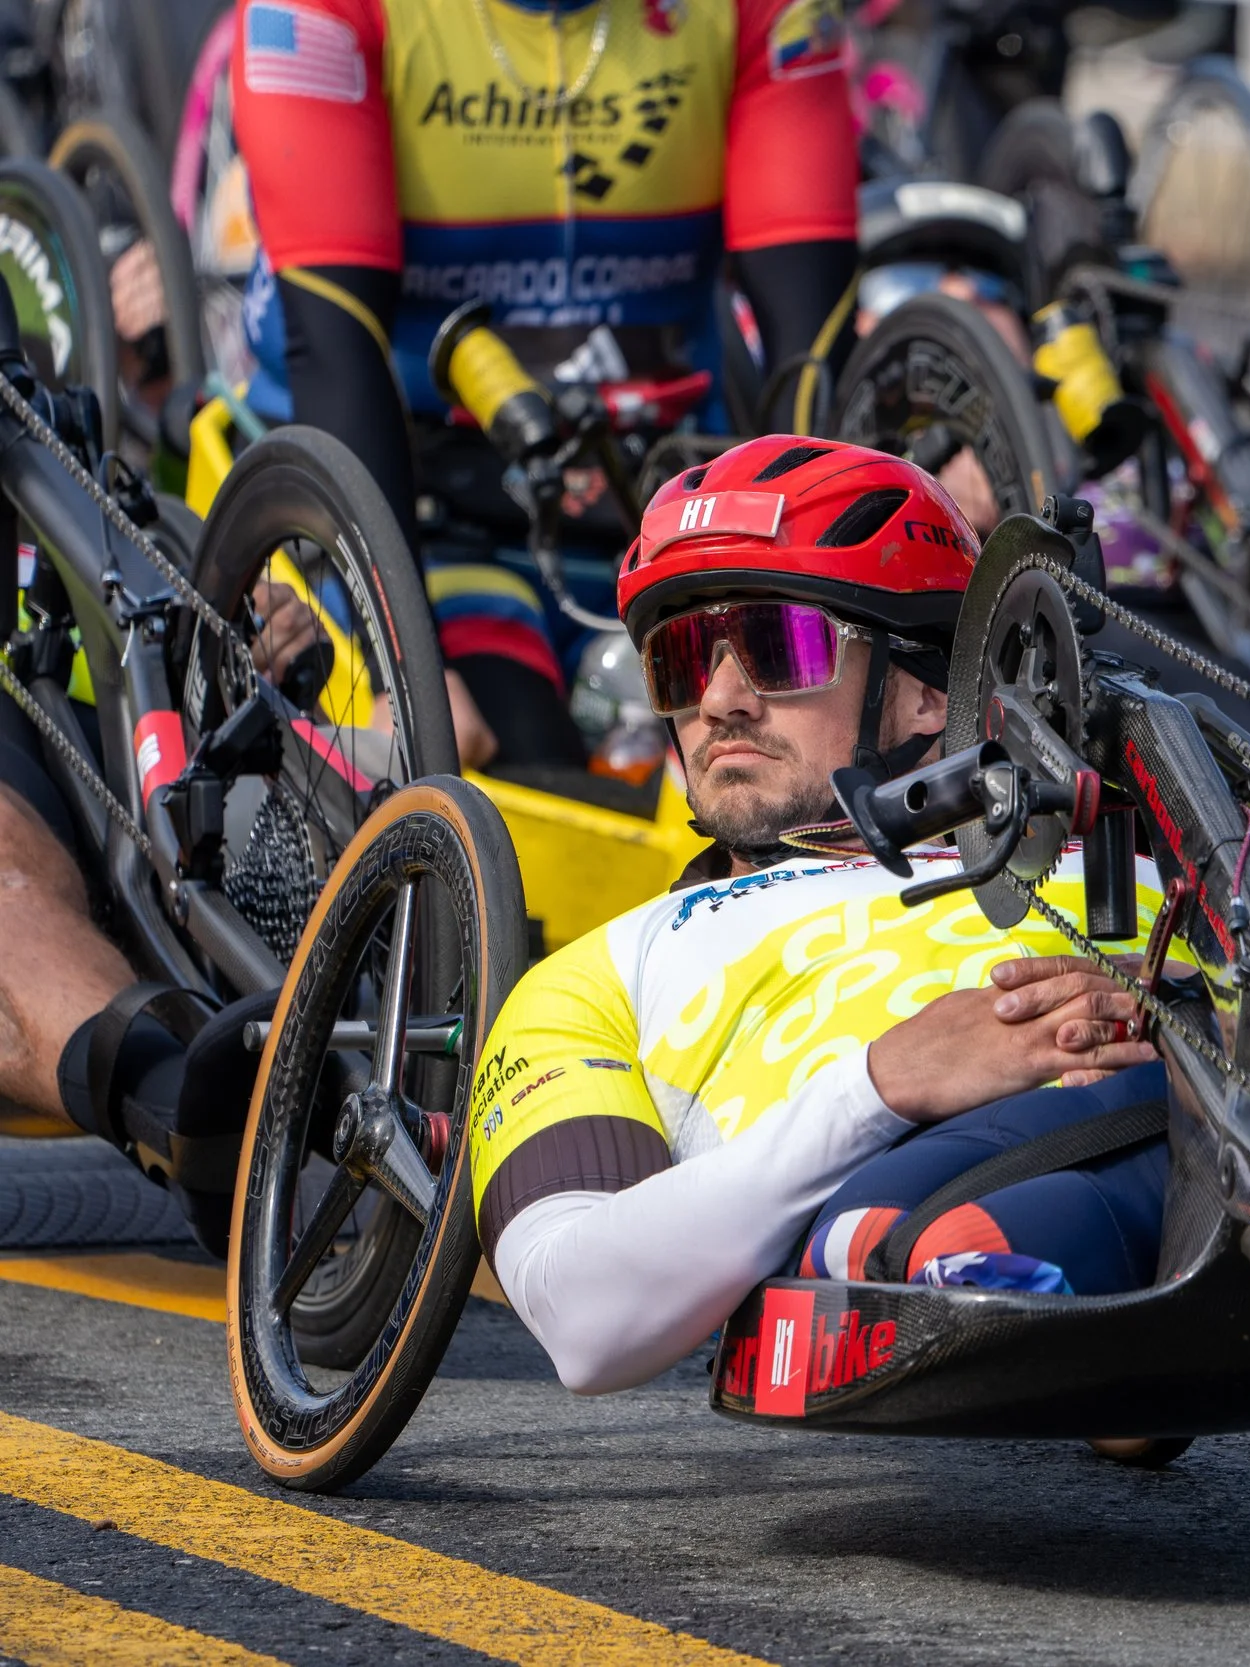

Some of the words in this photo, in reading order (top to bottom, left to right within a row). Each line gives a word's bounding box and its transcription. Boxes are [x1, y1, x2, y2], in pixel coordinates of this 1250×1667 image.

[420, 81, 622, 128] Achilles
[678, 496, 717, 531] H1
[511, 1067, 566, 1106] GMC
[771, 1319, 795, 1386] H1
